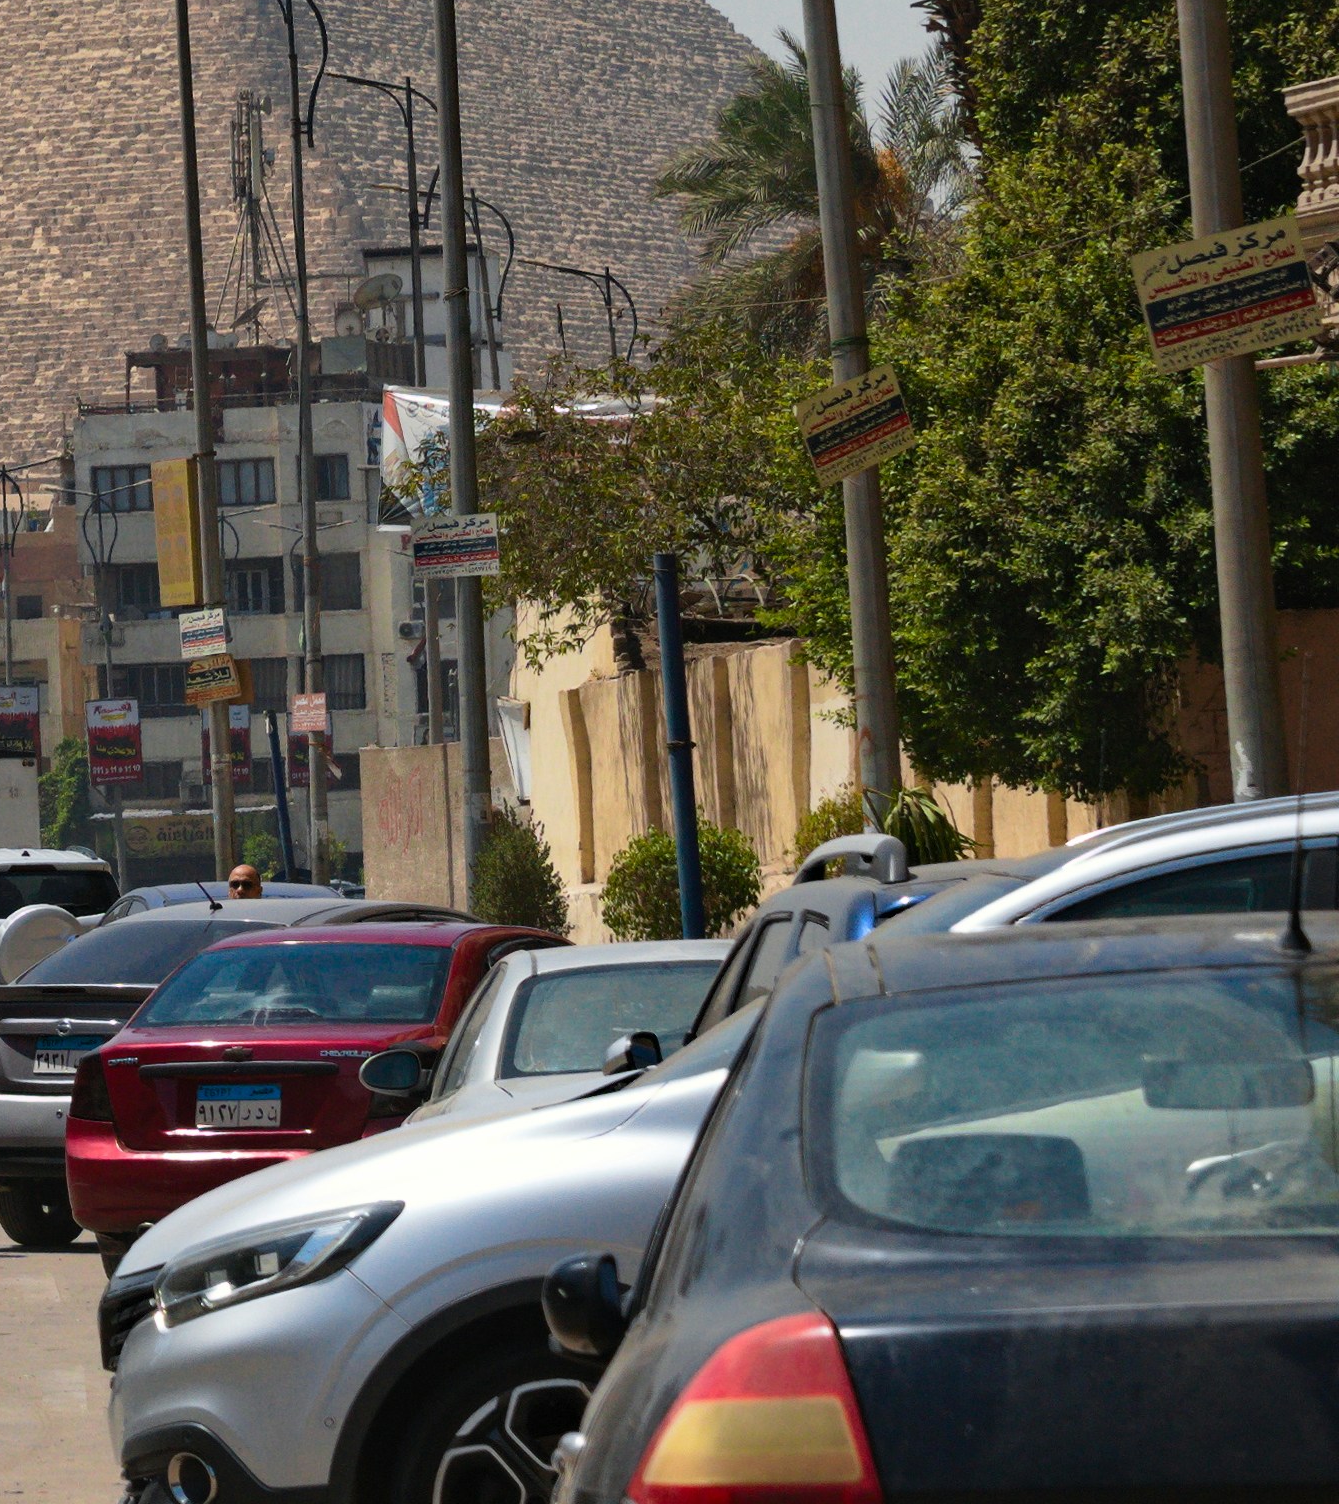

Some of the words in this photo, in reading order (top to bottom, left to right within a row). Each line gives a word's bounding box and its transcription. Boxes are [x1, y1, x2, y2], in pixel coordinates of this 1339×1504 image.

[1233, 229, 1286, 258] مركز
[1167, 241, 1228, 275] فيصل
[427, 519, 460, 532] فيصل
[462, 517, 490, 529] مركز
[320, 1050, 373, 1058] CHEVROLET
